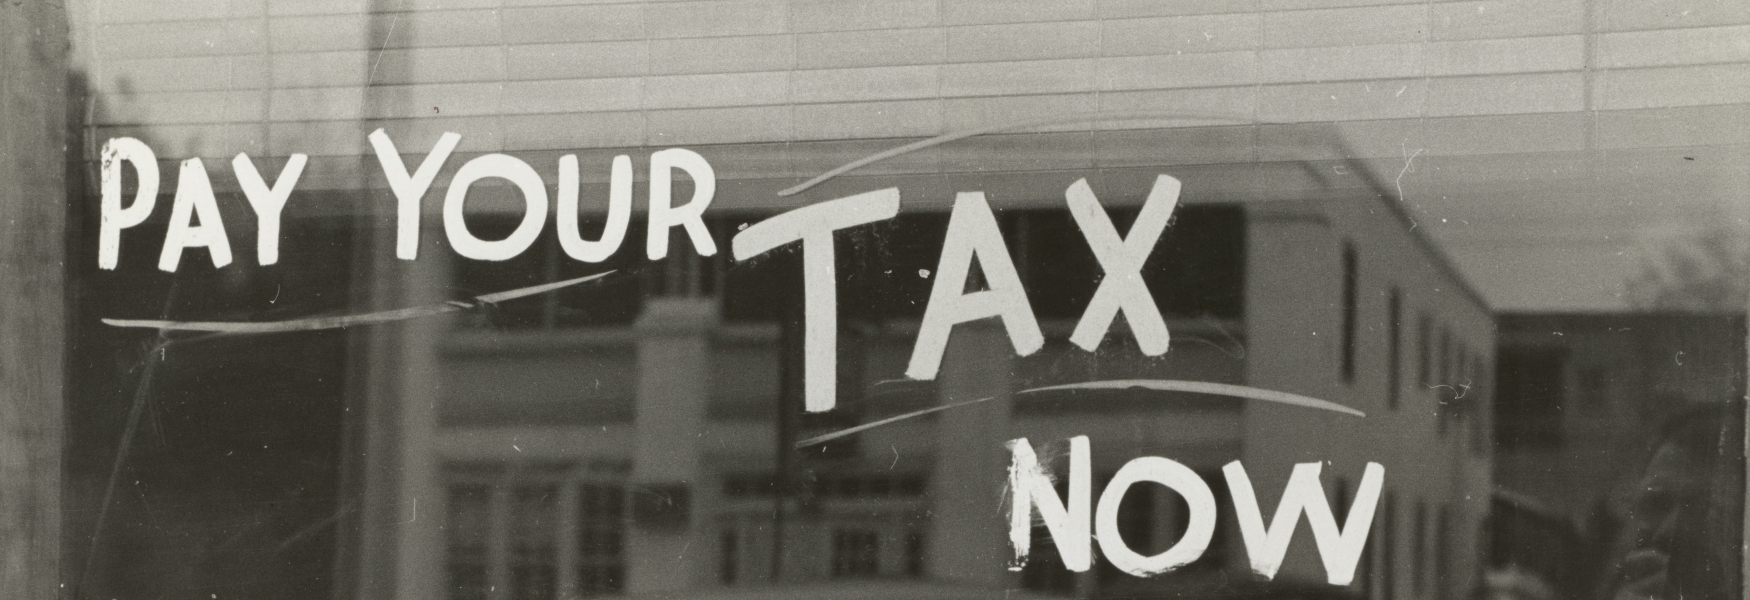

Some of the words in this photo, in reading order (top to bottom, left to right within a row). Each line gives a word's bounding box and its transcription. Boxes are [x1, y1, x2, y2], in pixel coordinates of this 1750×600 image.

[98, 137, 308, 272] PAY
[369, 128, 717, 263] YOUR
[731, 173, 1182, 413] TAX
[1007, 435, 1386, 586] NOW
